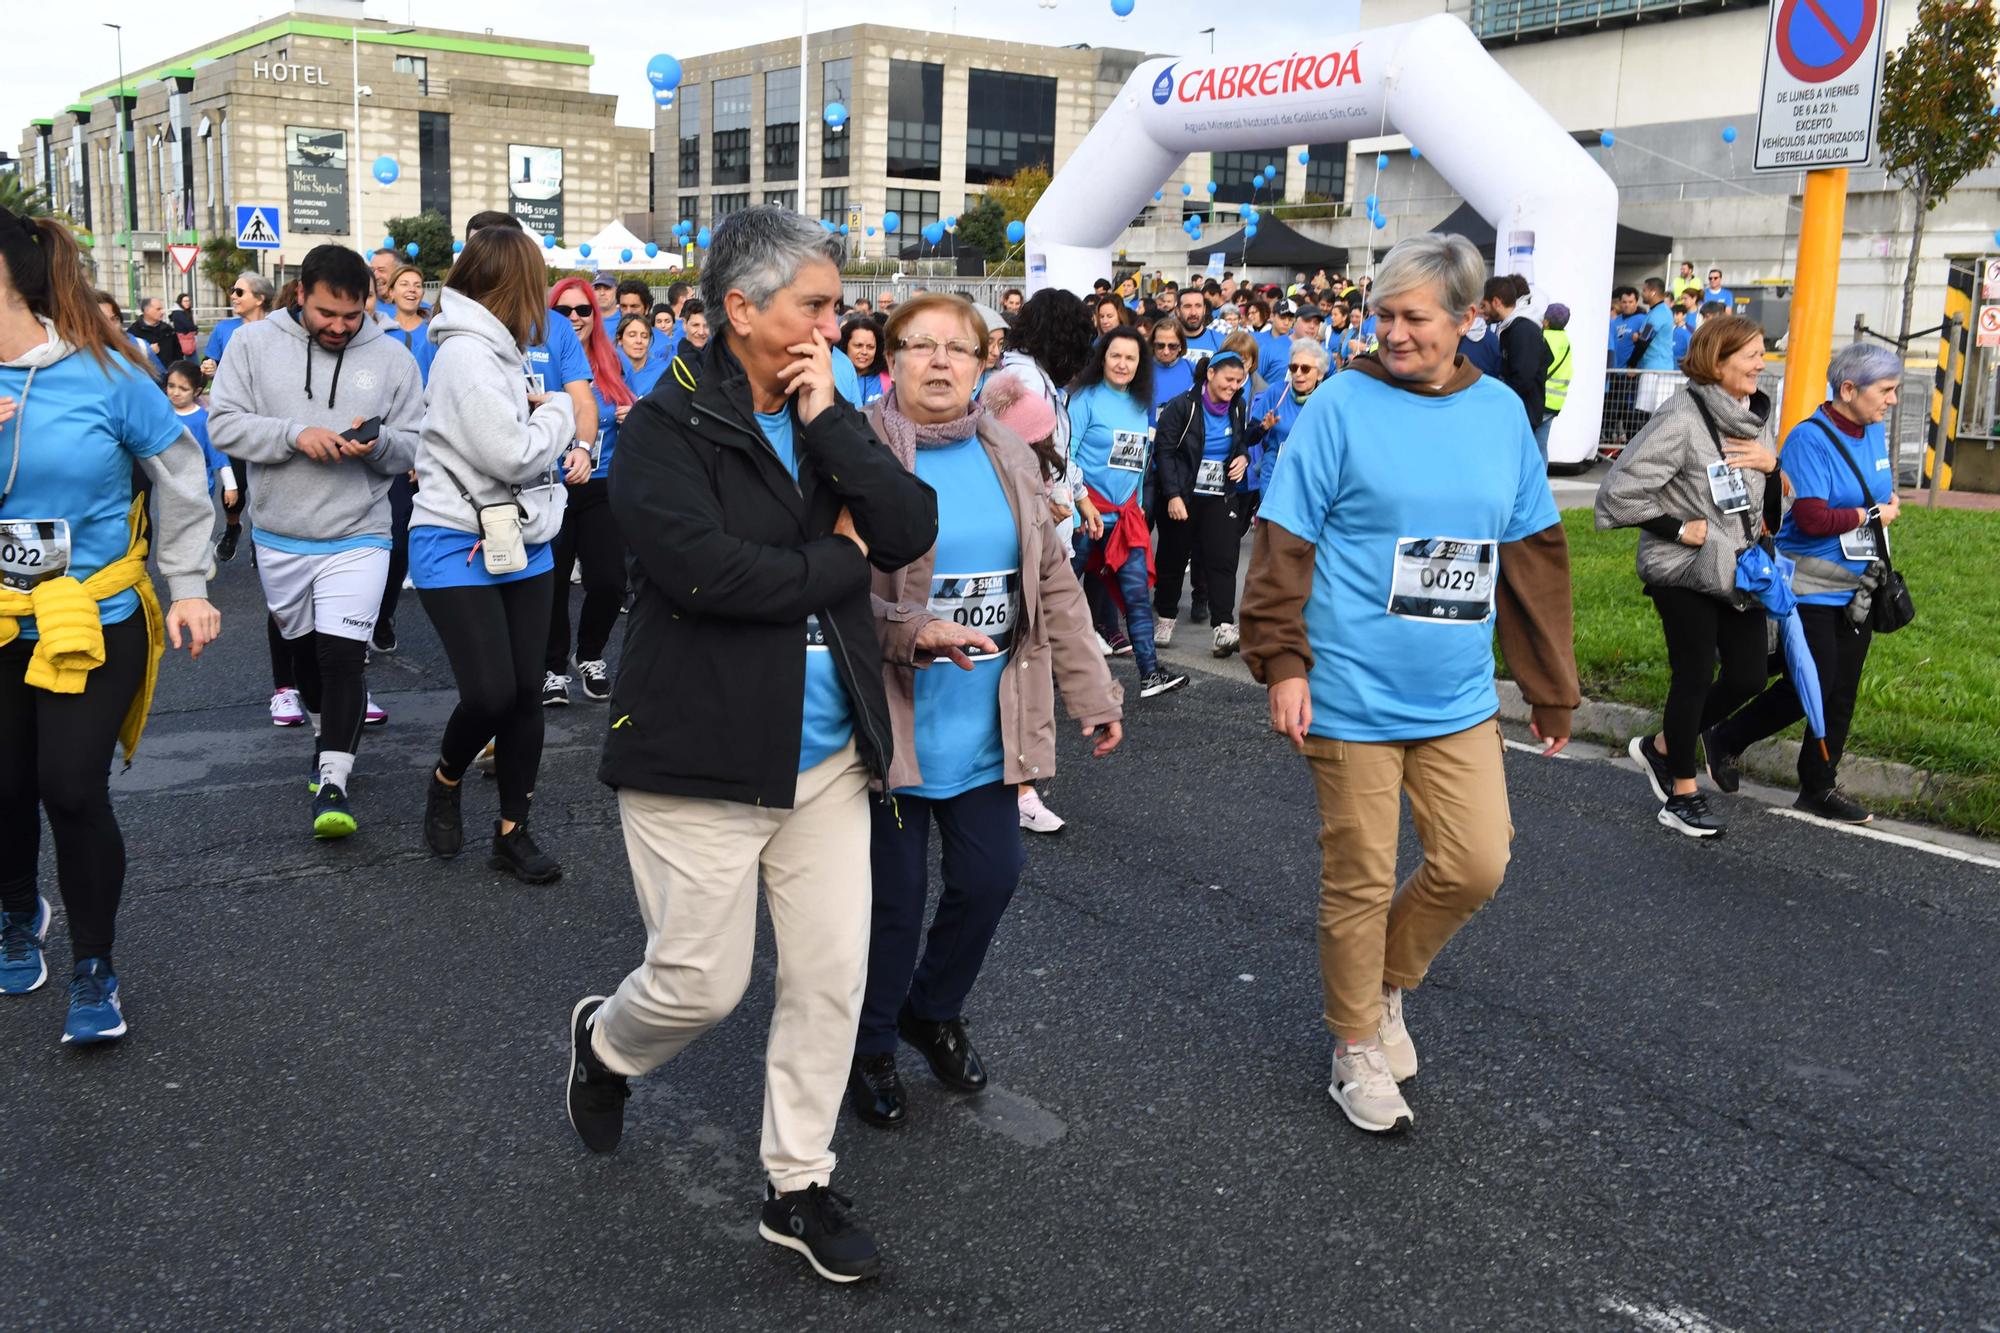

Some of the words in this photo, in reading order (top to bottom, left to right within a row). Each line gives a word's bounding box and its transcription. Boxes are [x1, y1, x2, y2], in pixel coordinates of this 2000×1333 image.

[254, 61, 329, 85] HOTEL
[1177, 41, 1363, 103] CABREÍROÁ
[1777, 91, 1787, 103] DE
[1789, 88, 1815, 102] LUNES
[1816, 88, 1823, 99] A
[1825, 84, 1860, 98] VIERNES
[1793, 105, 1804, 116] DE
[1806, 105, 1811, 115] 6
[1812, 103, 1818, 114] A
[1820, 103, 1829, 113] 22
[1184, 121, 1207, 135] Agua
[1208, 118, 1242, 131] Mineral
[1243, 114, 1280, 128] Natural
[1281, 113, 1293, 124] de
[1294, 109, 1328, 123] Galicia
[1329, 107, 1346, 119] Sin
[1347, 105, 1367, 118] Gas
[1796, 117, 1833, 131] EXCEPTO
[1762, 134, 1806, 149] VEHÍCULOS
[1807, 130, 1866, 146] AUTORIZADOS
[1775, 150, 1814, 163] ESTRELLA
[1816, 147, 1849, 160] GALICIA
[293, 170, 316, 181] Meet
[293, 180, 311, 192] Ibis
[312, 181, 342, 196] Styles!
[515, 201, 533, 214] ibis
[534, 206, 558, 216] STYLES
[978, 577, 1003, 591] 5KM
[1420, 566, 1476, 592] 0029
[953, 603, 1006, 627] 0026
